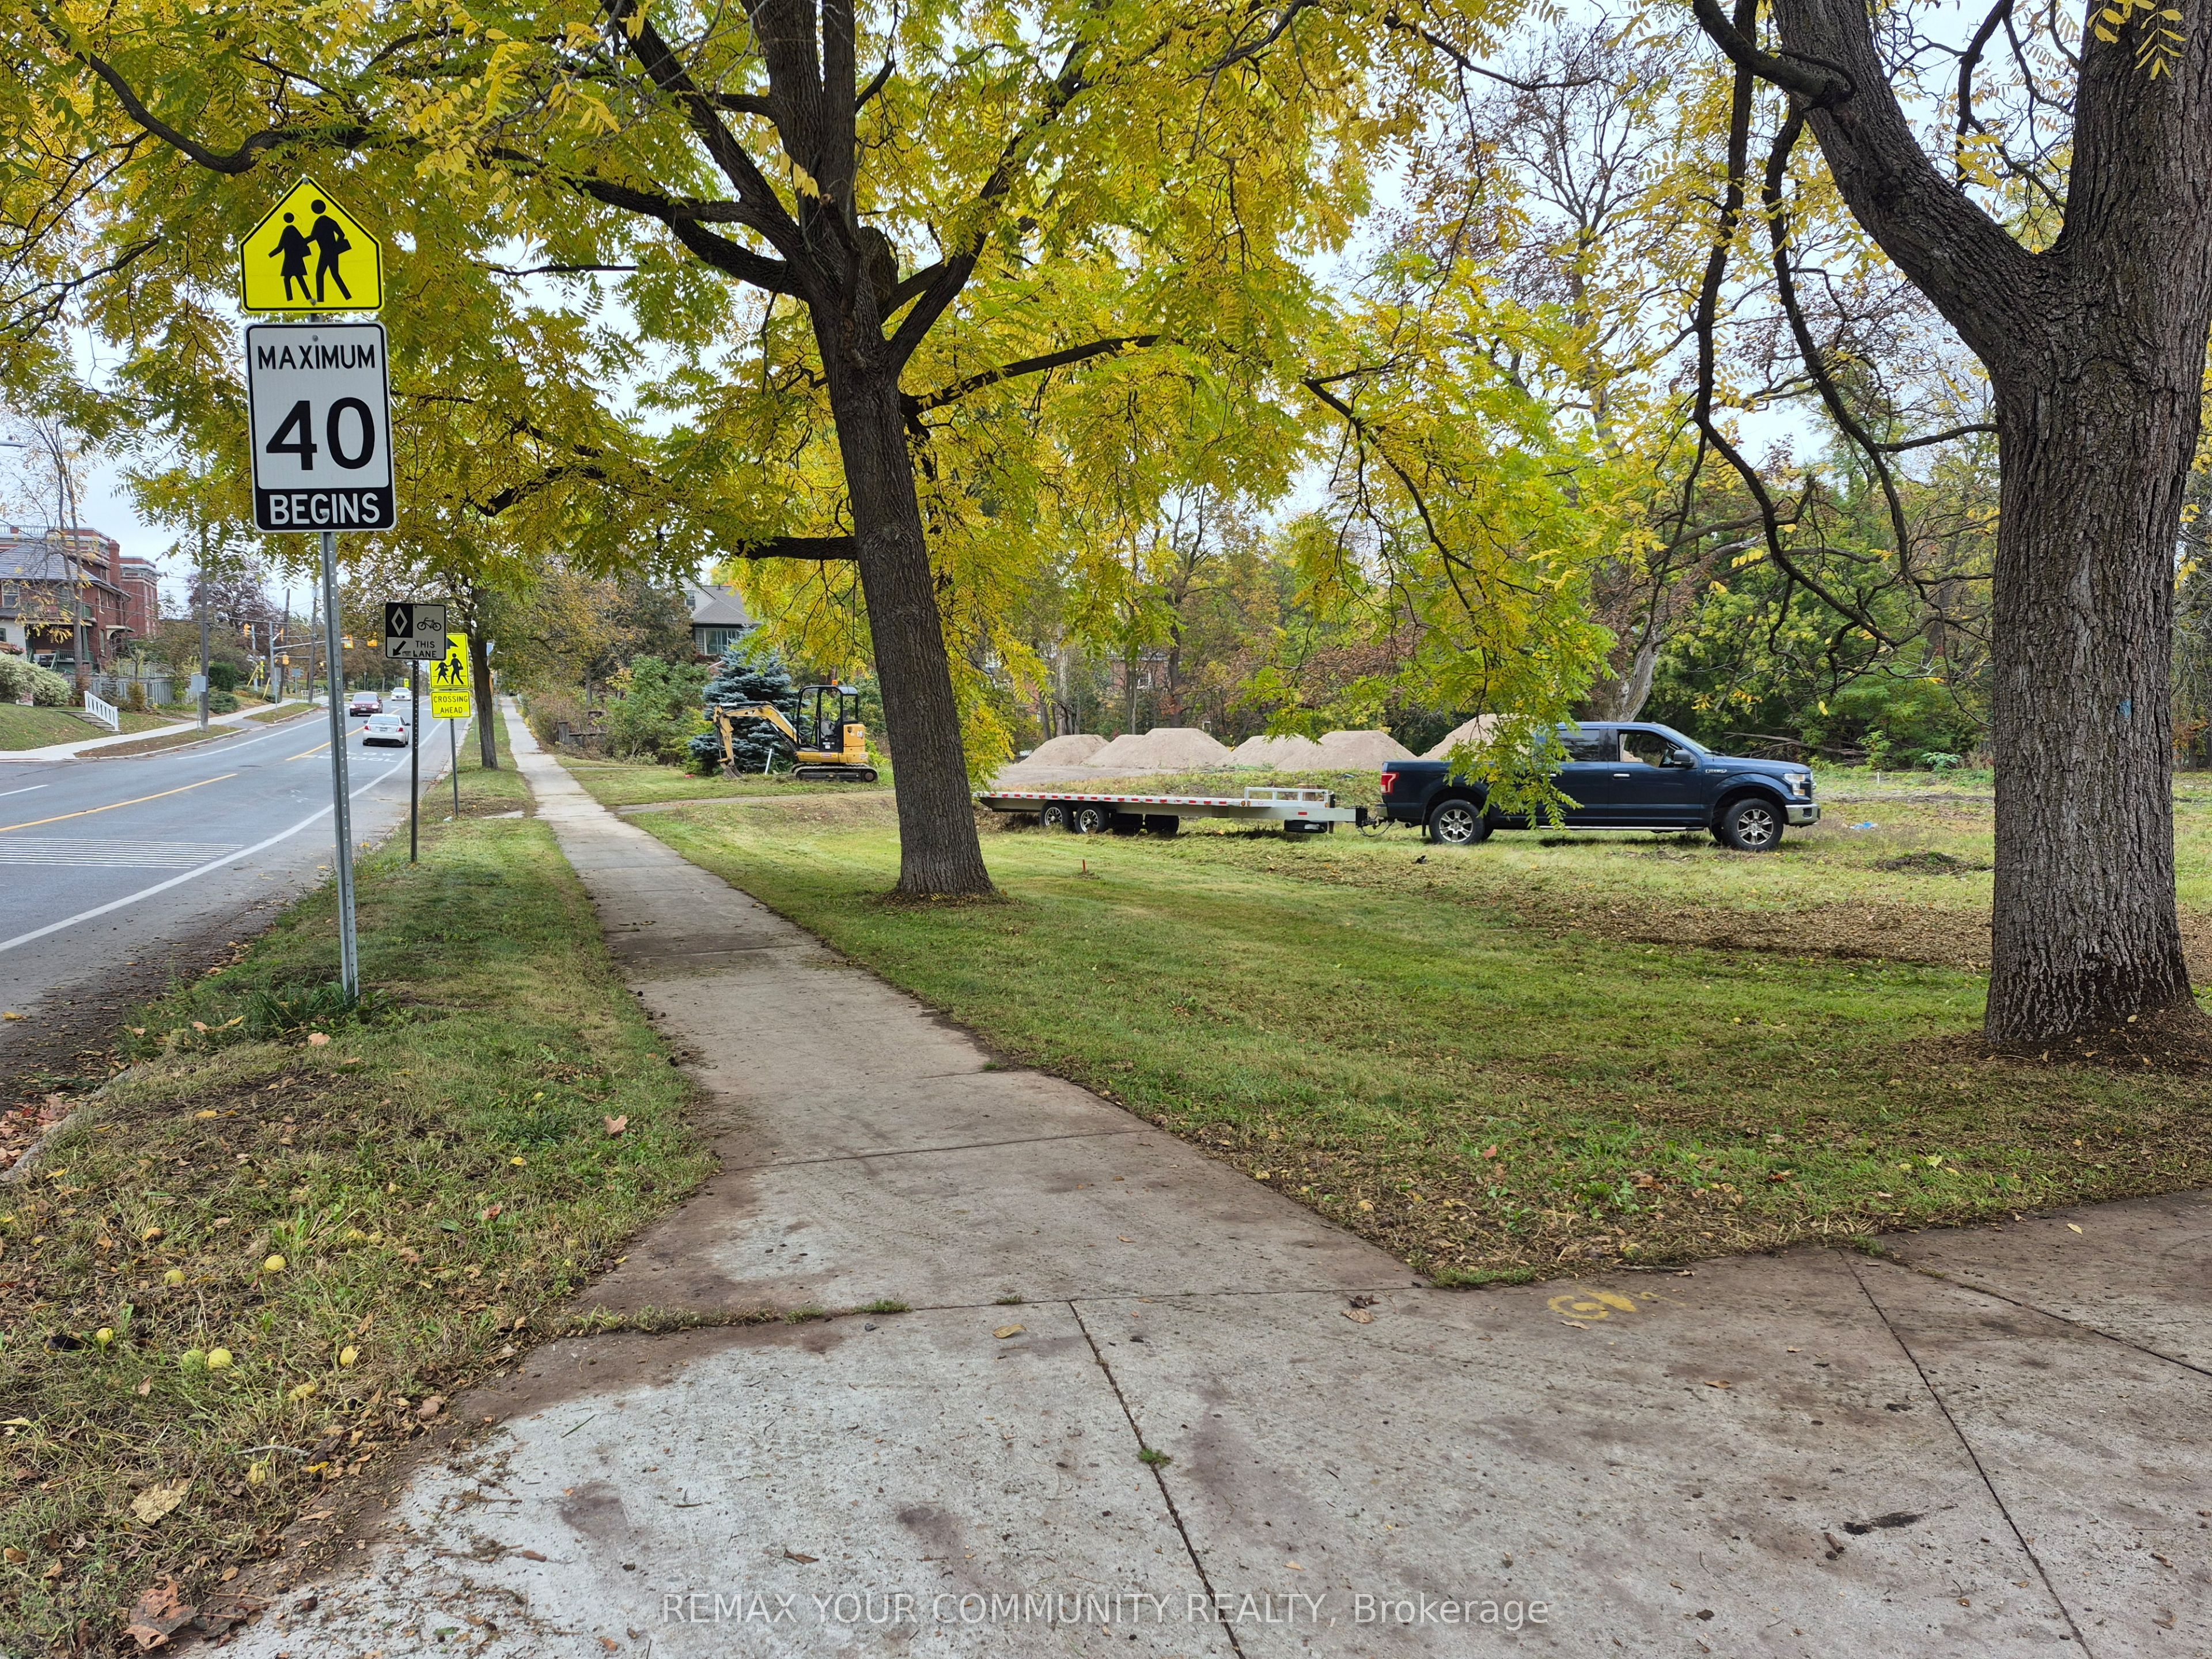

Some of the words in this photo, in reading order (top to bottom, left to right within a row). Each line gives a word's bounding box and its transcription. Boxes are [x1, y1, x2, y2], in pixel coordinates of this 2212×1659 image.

[258, 344, 376, 370] MAXIMUM
[266, 397, 375, 471] 40
[270, 493, 380, 525] BEGINS
[415, 640, 435, 648] THIS
[440, 706, 463, 714] AHEAD
